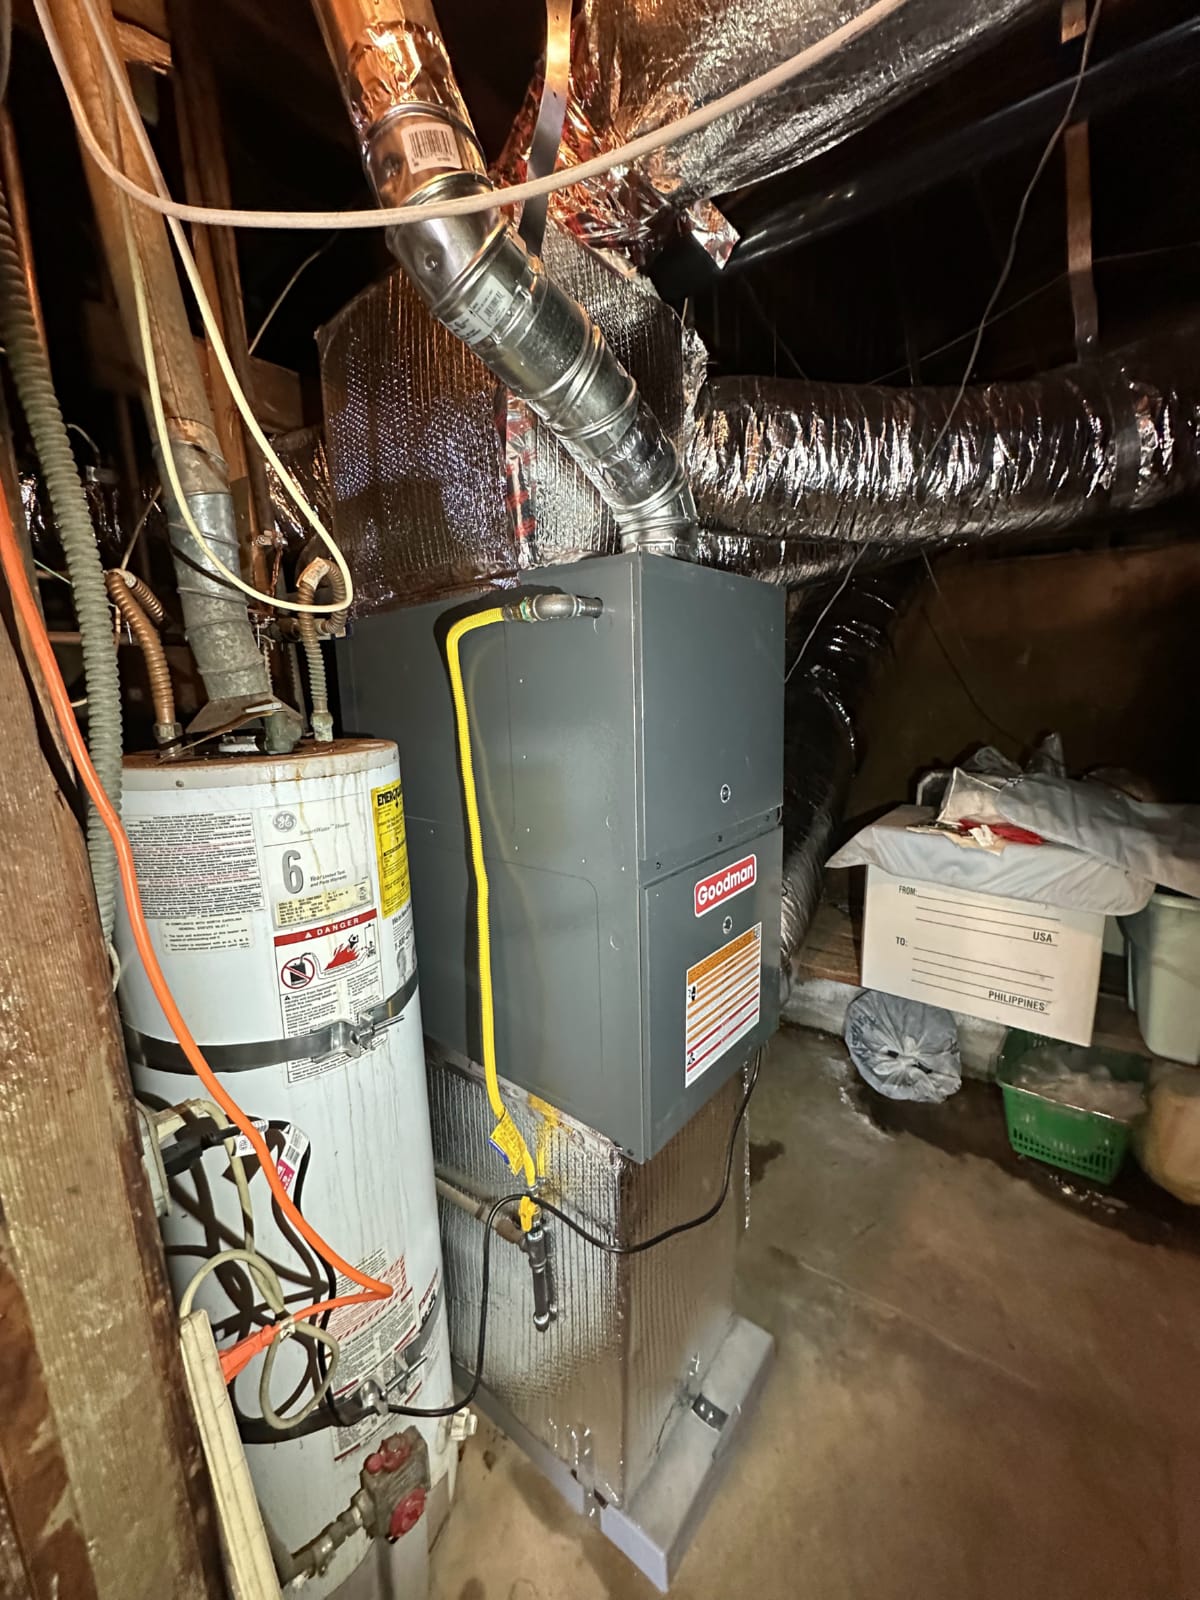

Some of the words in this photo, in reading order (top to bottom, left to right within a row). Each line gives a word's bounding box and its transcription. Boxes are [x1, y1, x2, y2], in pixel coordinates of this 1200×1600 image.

[281, 849, 304, 895] 6
[698, 864, 754, 906] Goodman
[898, 884, 917, 897] FROM:
[316, 917, 359, 936] DANGER
[895, 936, 908, 947] TO:
[1032, 931, 1053, 943] USA
[988, 990, 1046, 1011] PHILIPPINES
